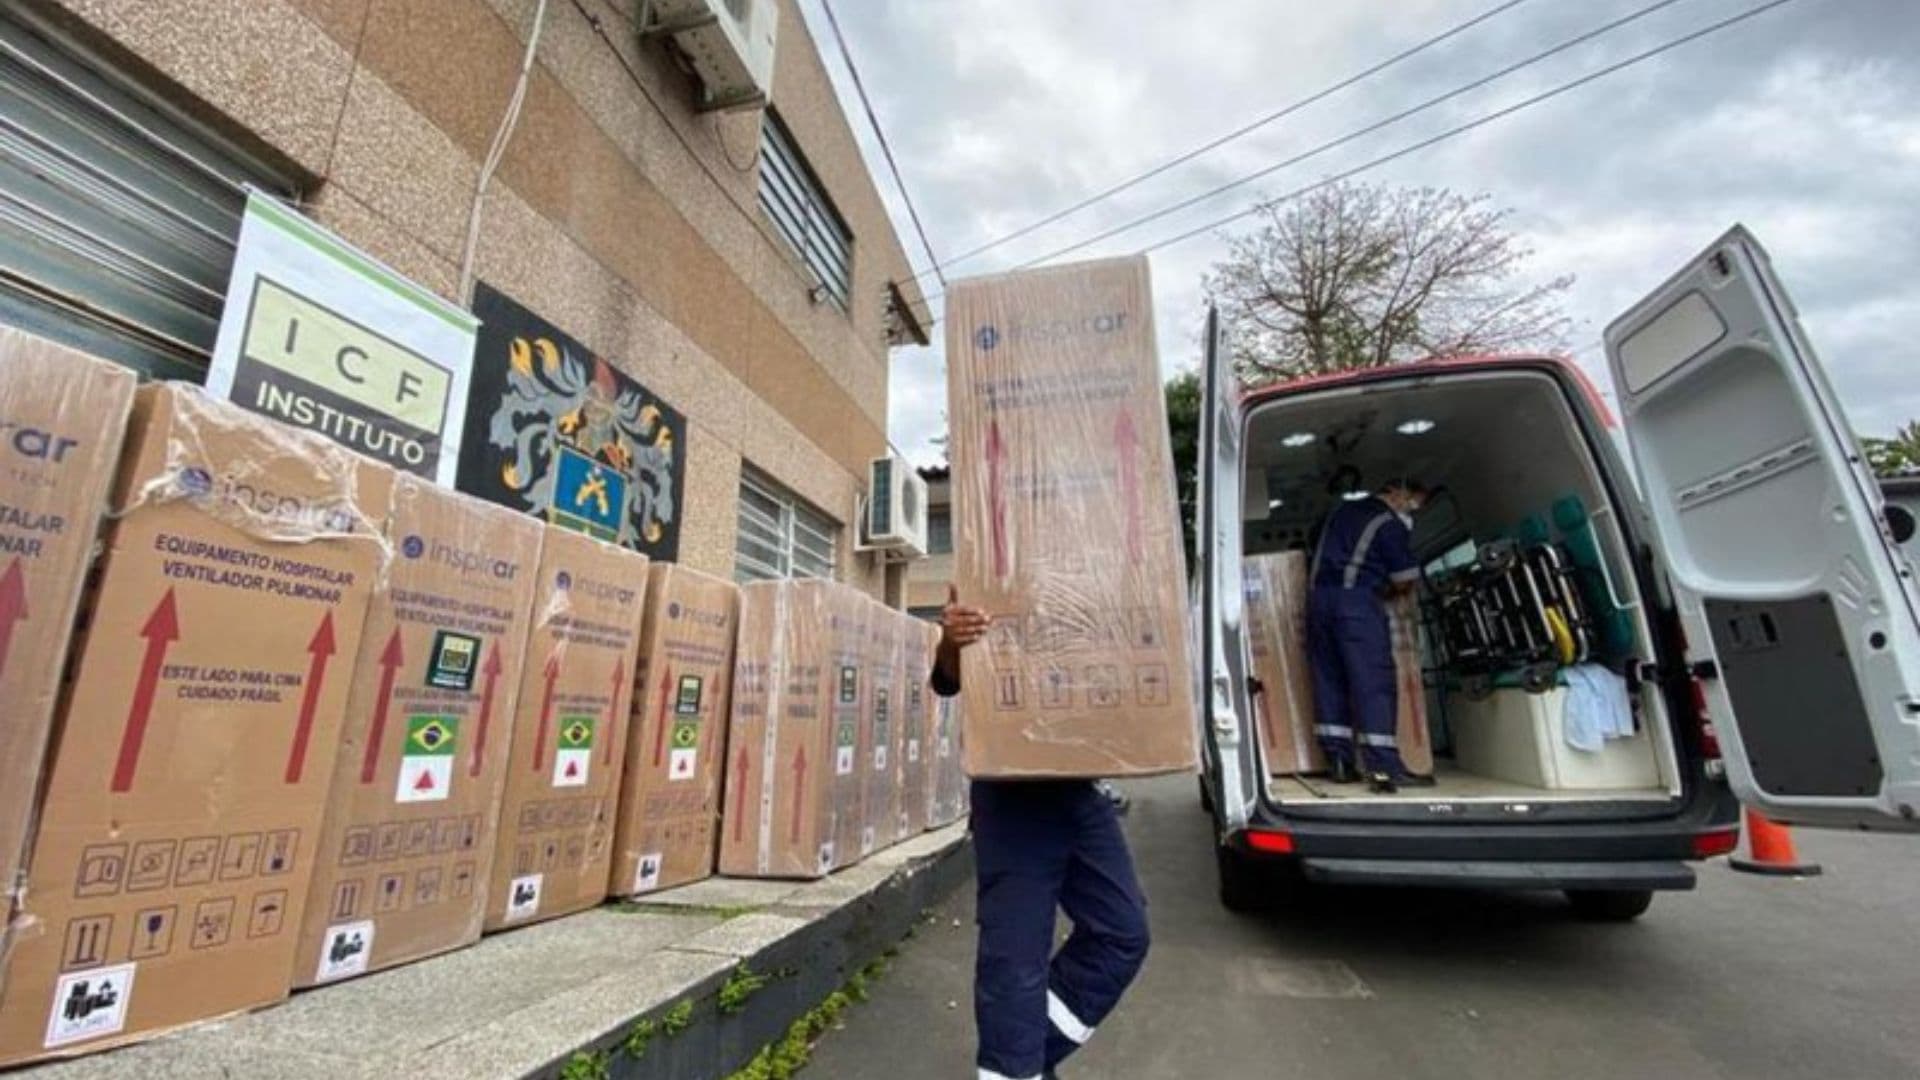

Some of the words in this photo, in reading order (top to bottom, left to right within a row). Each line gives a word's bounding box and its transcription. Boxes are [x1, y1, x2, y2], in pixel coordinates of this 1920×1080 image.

[0, 420, 78, 463] ar
[256, 380, 425, 465] INSTITUTO
[155, 533, 270, 570] EQUIPAMENTO
[272, 559, 355, 586] HOSPITALAR
[428, 536, 520, 580] inspirar
[163, 559, 265, 591] VENTILADOR
[266, 577, 342, 604] PULMONAR
[163, 665, 199, 682] ESTE
[200, 667, 238, 683] LADO
[240, 670, 271, 685] PARA
[177, 684, 238, 701] CUIDADO
